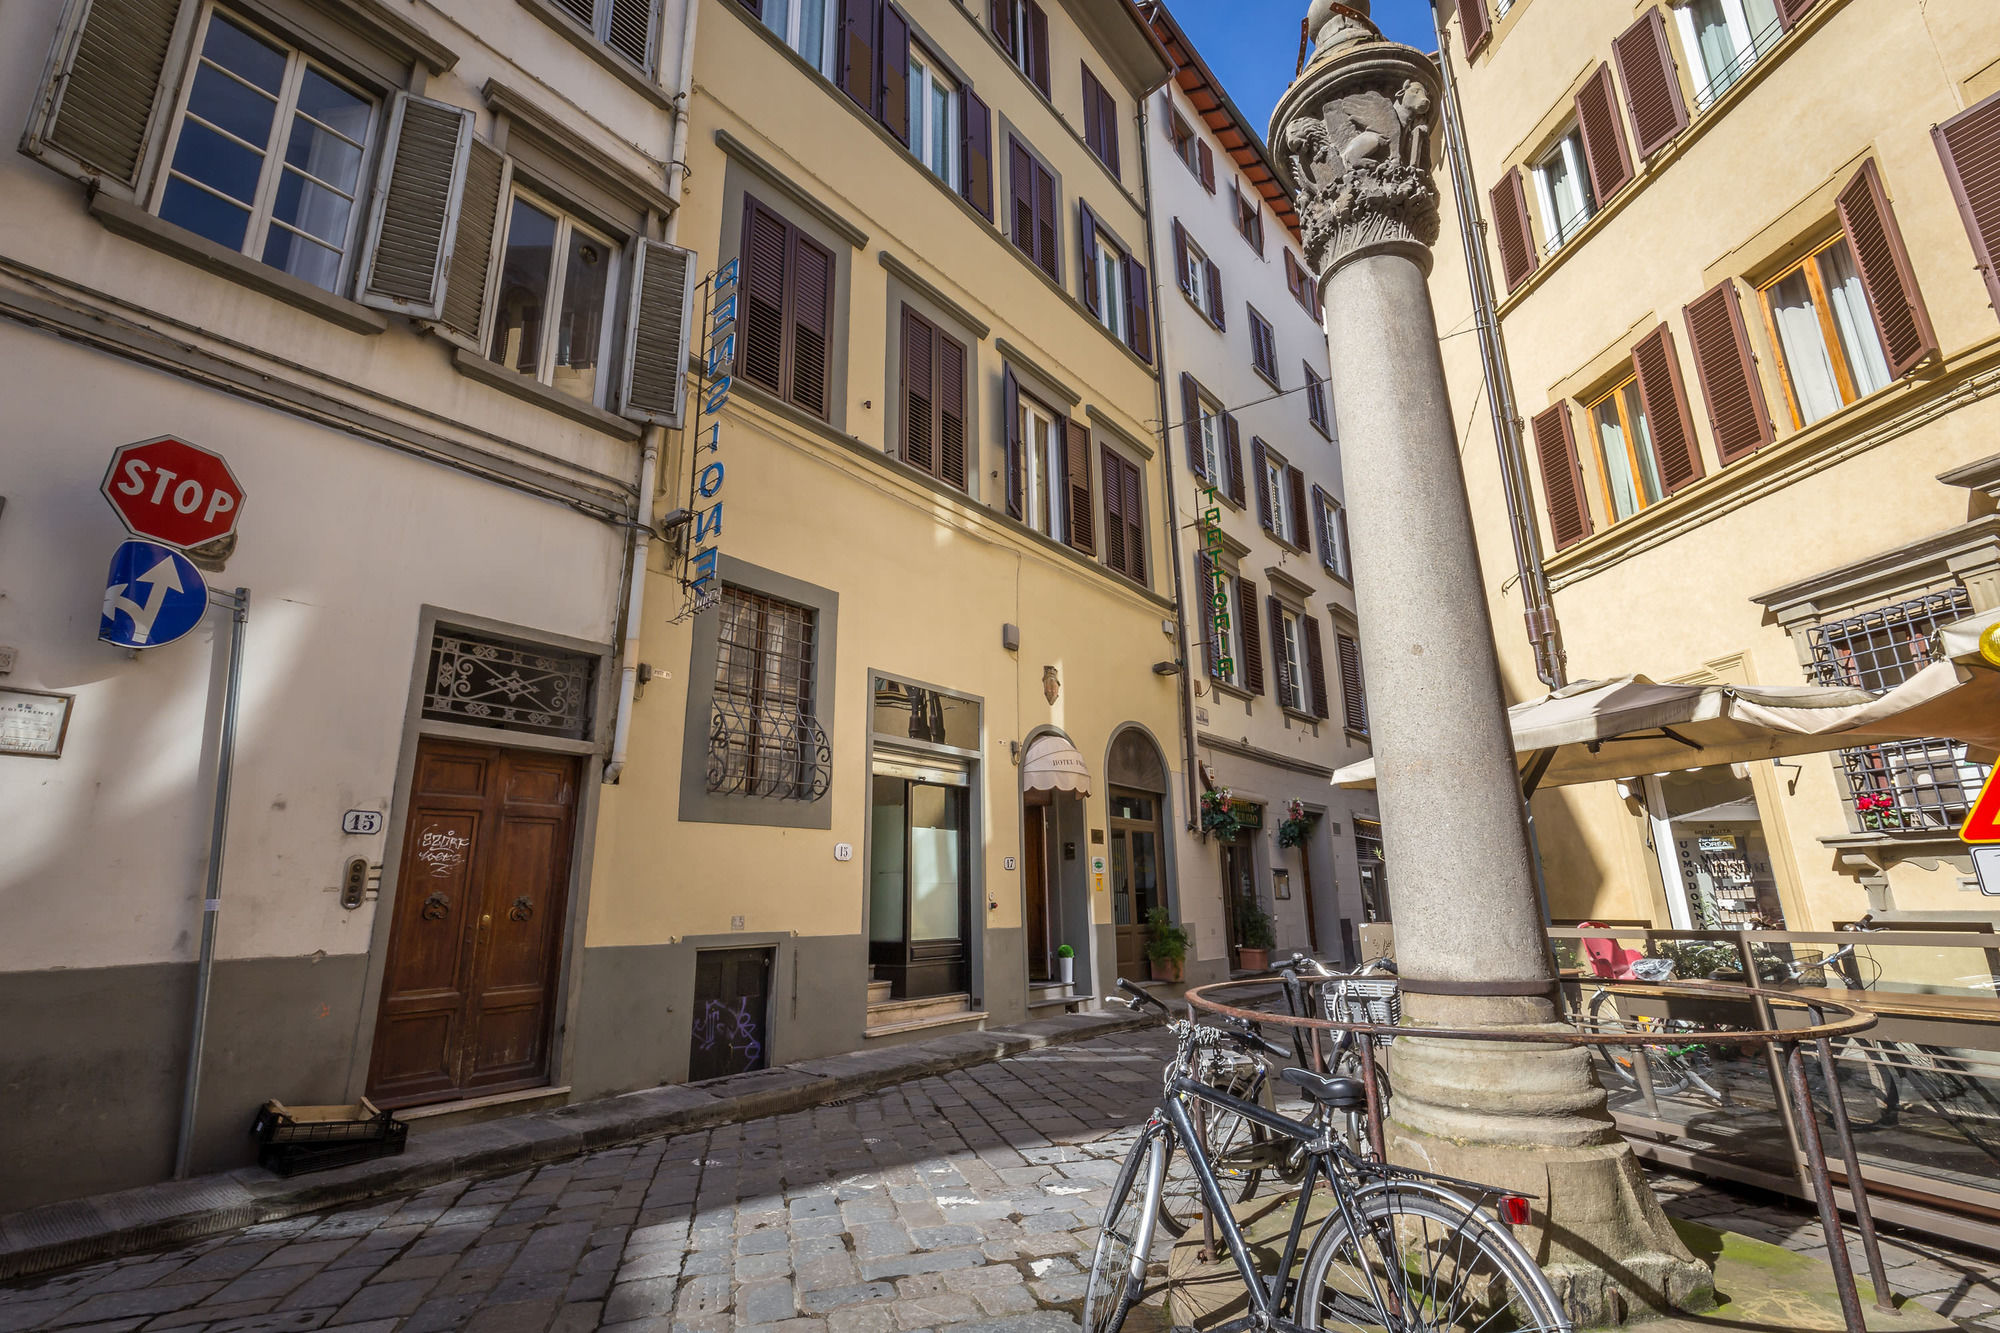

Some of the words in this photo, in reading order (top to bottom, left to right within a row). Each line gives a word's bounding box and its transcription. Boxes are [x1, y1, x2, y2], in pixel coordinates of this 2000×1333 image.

[117, 459, 234, 523] STOP
[350, 814, 375, 831] 15
[1006, 859, 1014, 868] 17
[1680, 841, 1694, 877] UOMO
[1688, 883, 1707, 930] DONNA
